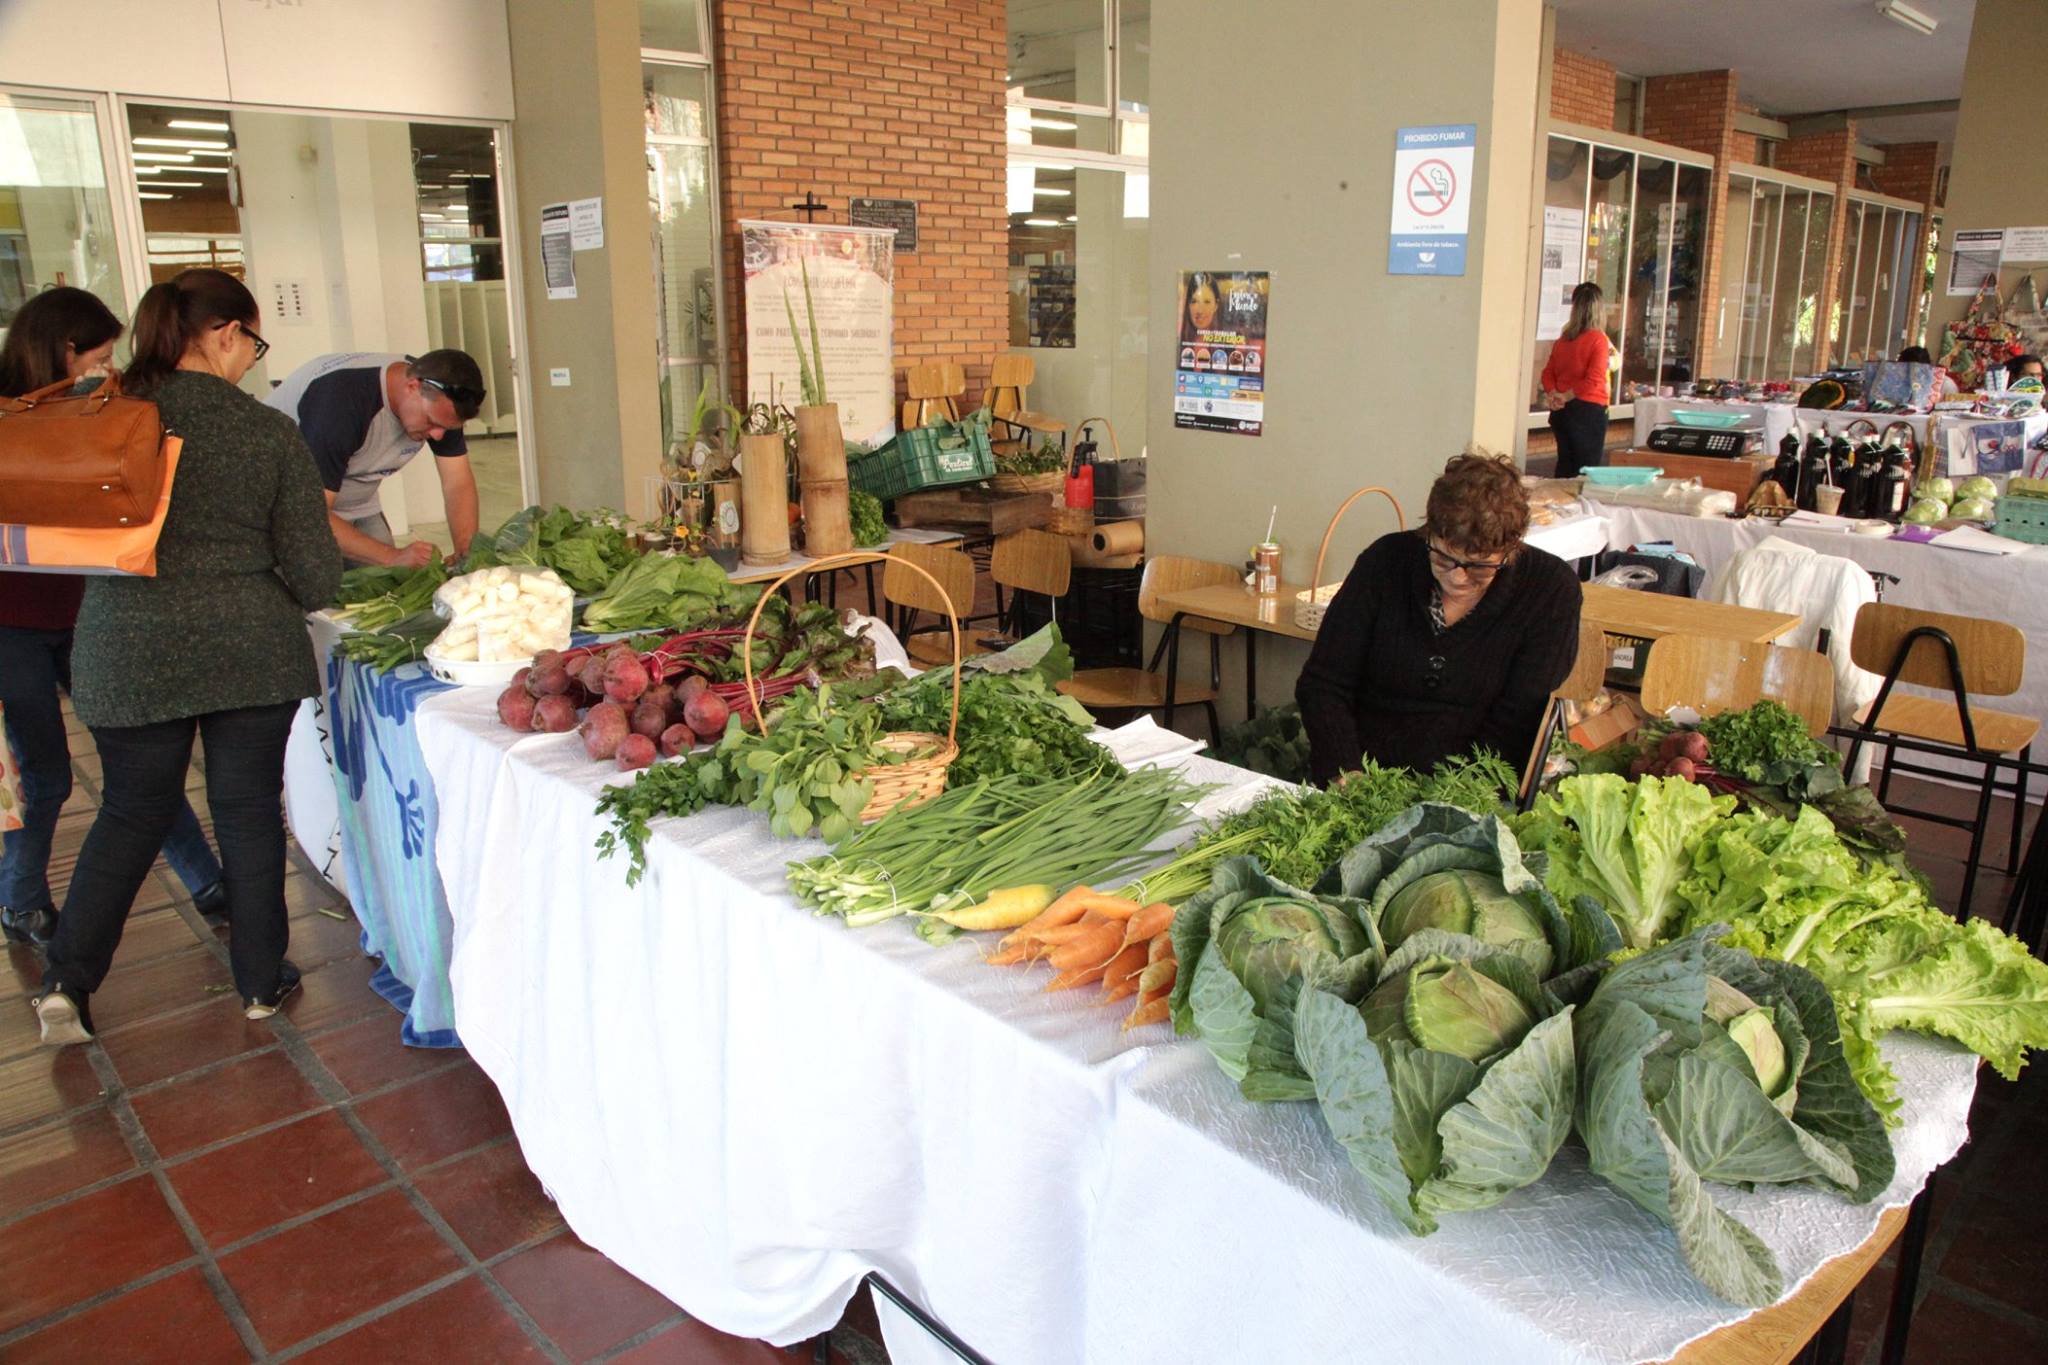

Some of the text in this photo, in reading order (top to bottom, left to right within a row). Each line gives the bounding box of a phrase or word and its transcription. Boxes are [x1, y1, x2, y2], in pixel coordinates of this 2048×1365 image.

[1403, 131, 1466, 144] PROIBIDO FUMAR
[1203, 334, 1213, 342] NO
[1213, 335, 1245, 345] EXTERIOR
